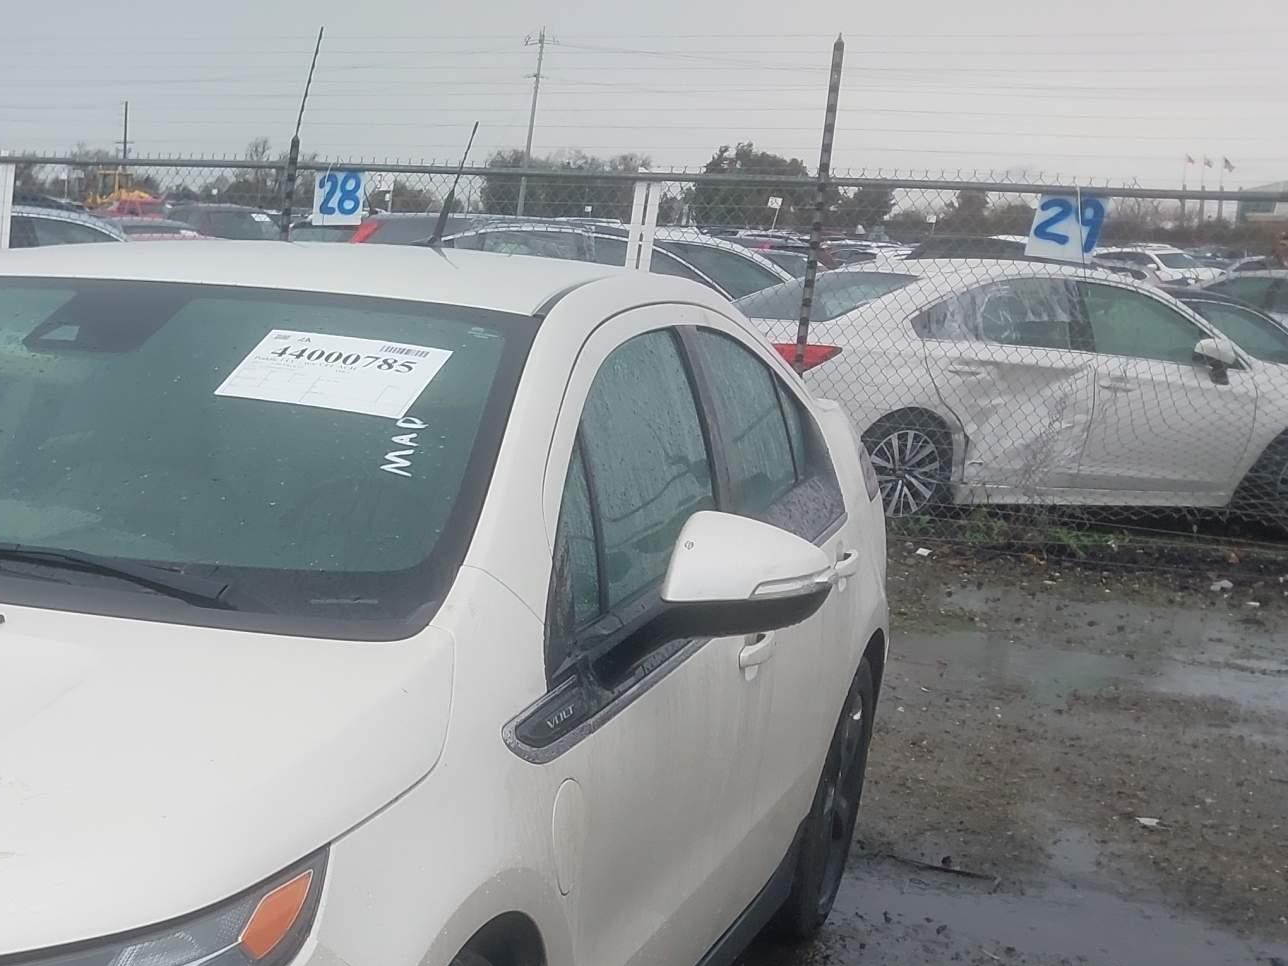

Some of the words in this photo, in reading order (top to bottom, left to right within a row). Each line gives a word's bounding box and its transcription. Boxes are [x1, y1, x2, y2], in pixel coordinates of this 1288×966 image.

[318, 172, 361, 215] 28
[1034, 196, 1104, 253] 29
[271, 345, 417, 374] 44000785
